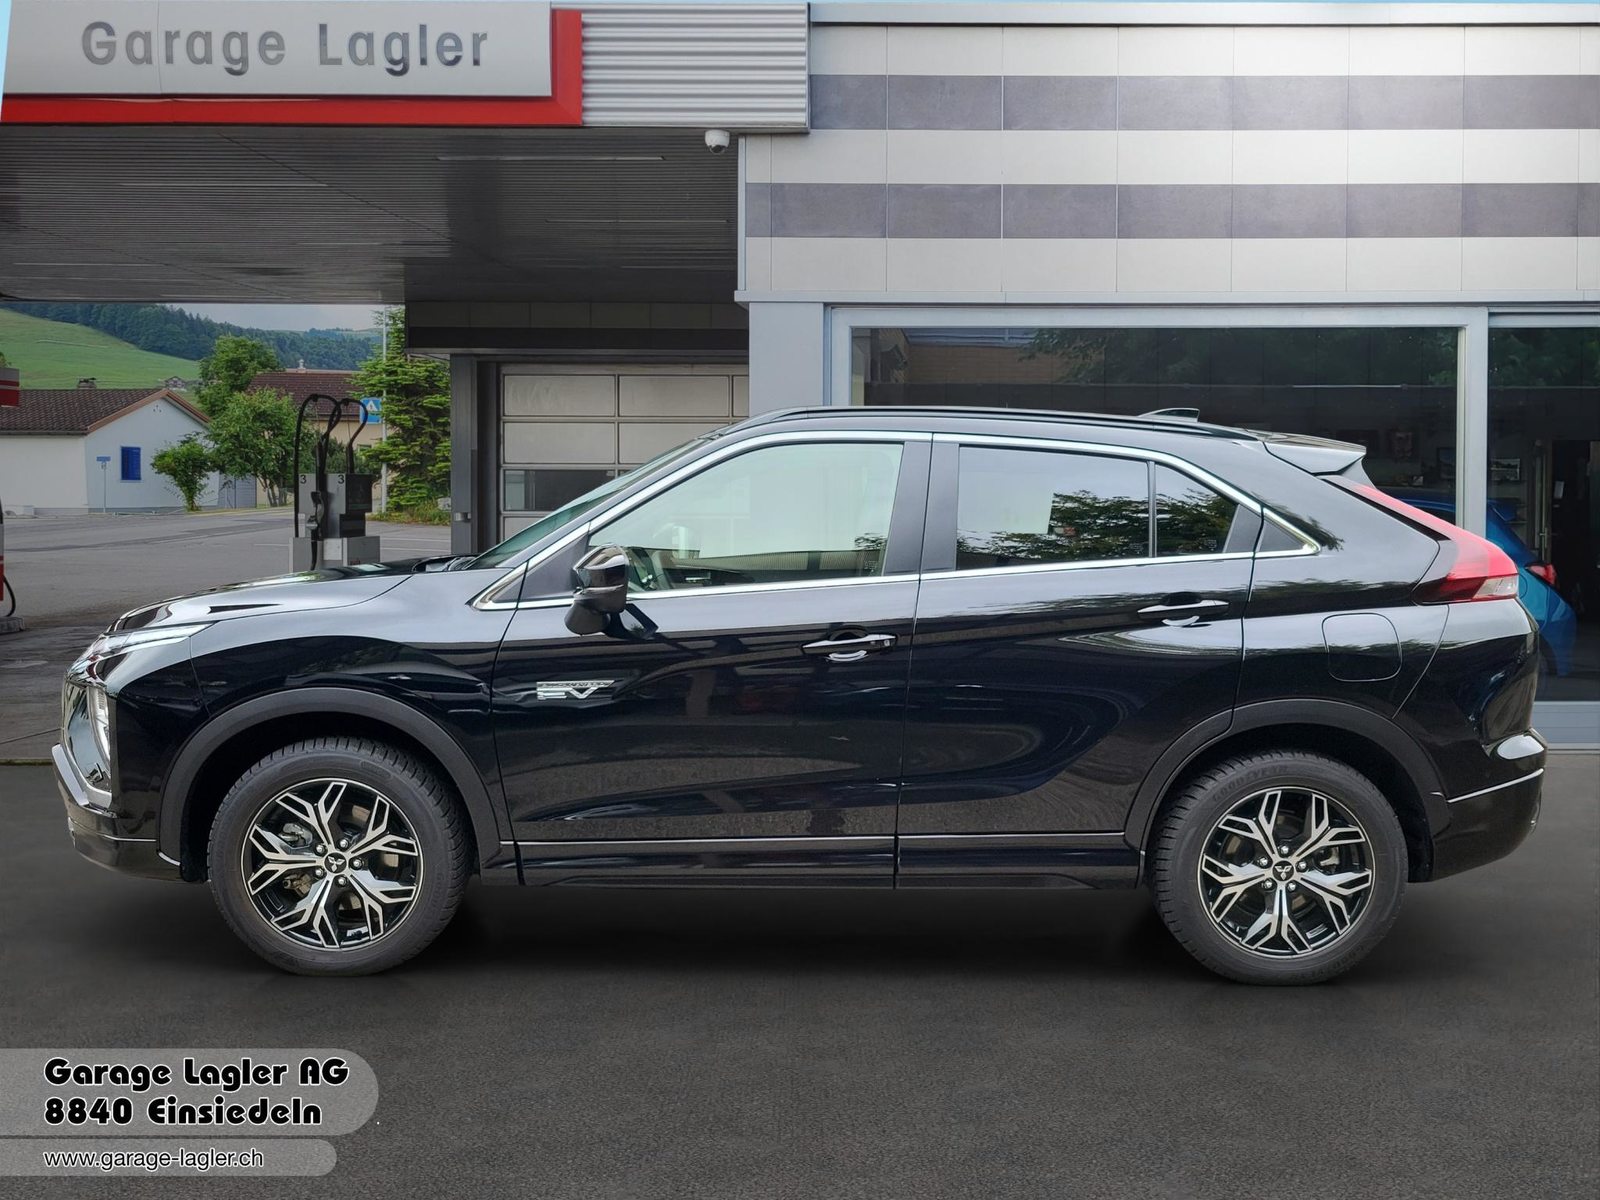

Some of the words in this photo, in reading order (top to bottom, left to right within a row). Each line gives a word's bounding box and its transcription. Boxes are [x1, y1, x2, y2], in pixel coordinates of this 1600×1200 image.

[81, 20, 286, 77] Garage
[318, 23, 488, 77] Lagler
[300, 474, 307, 485] 3
[338, 474, 345, 485] 3
